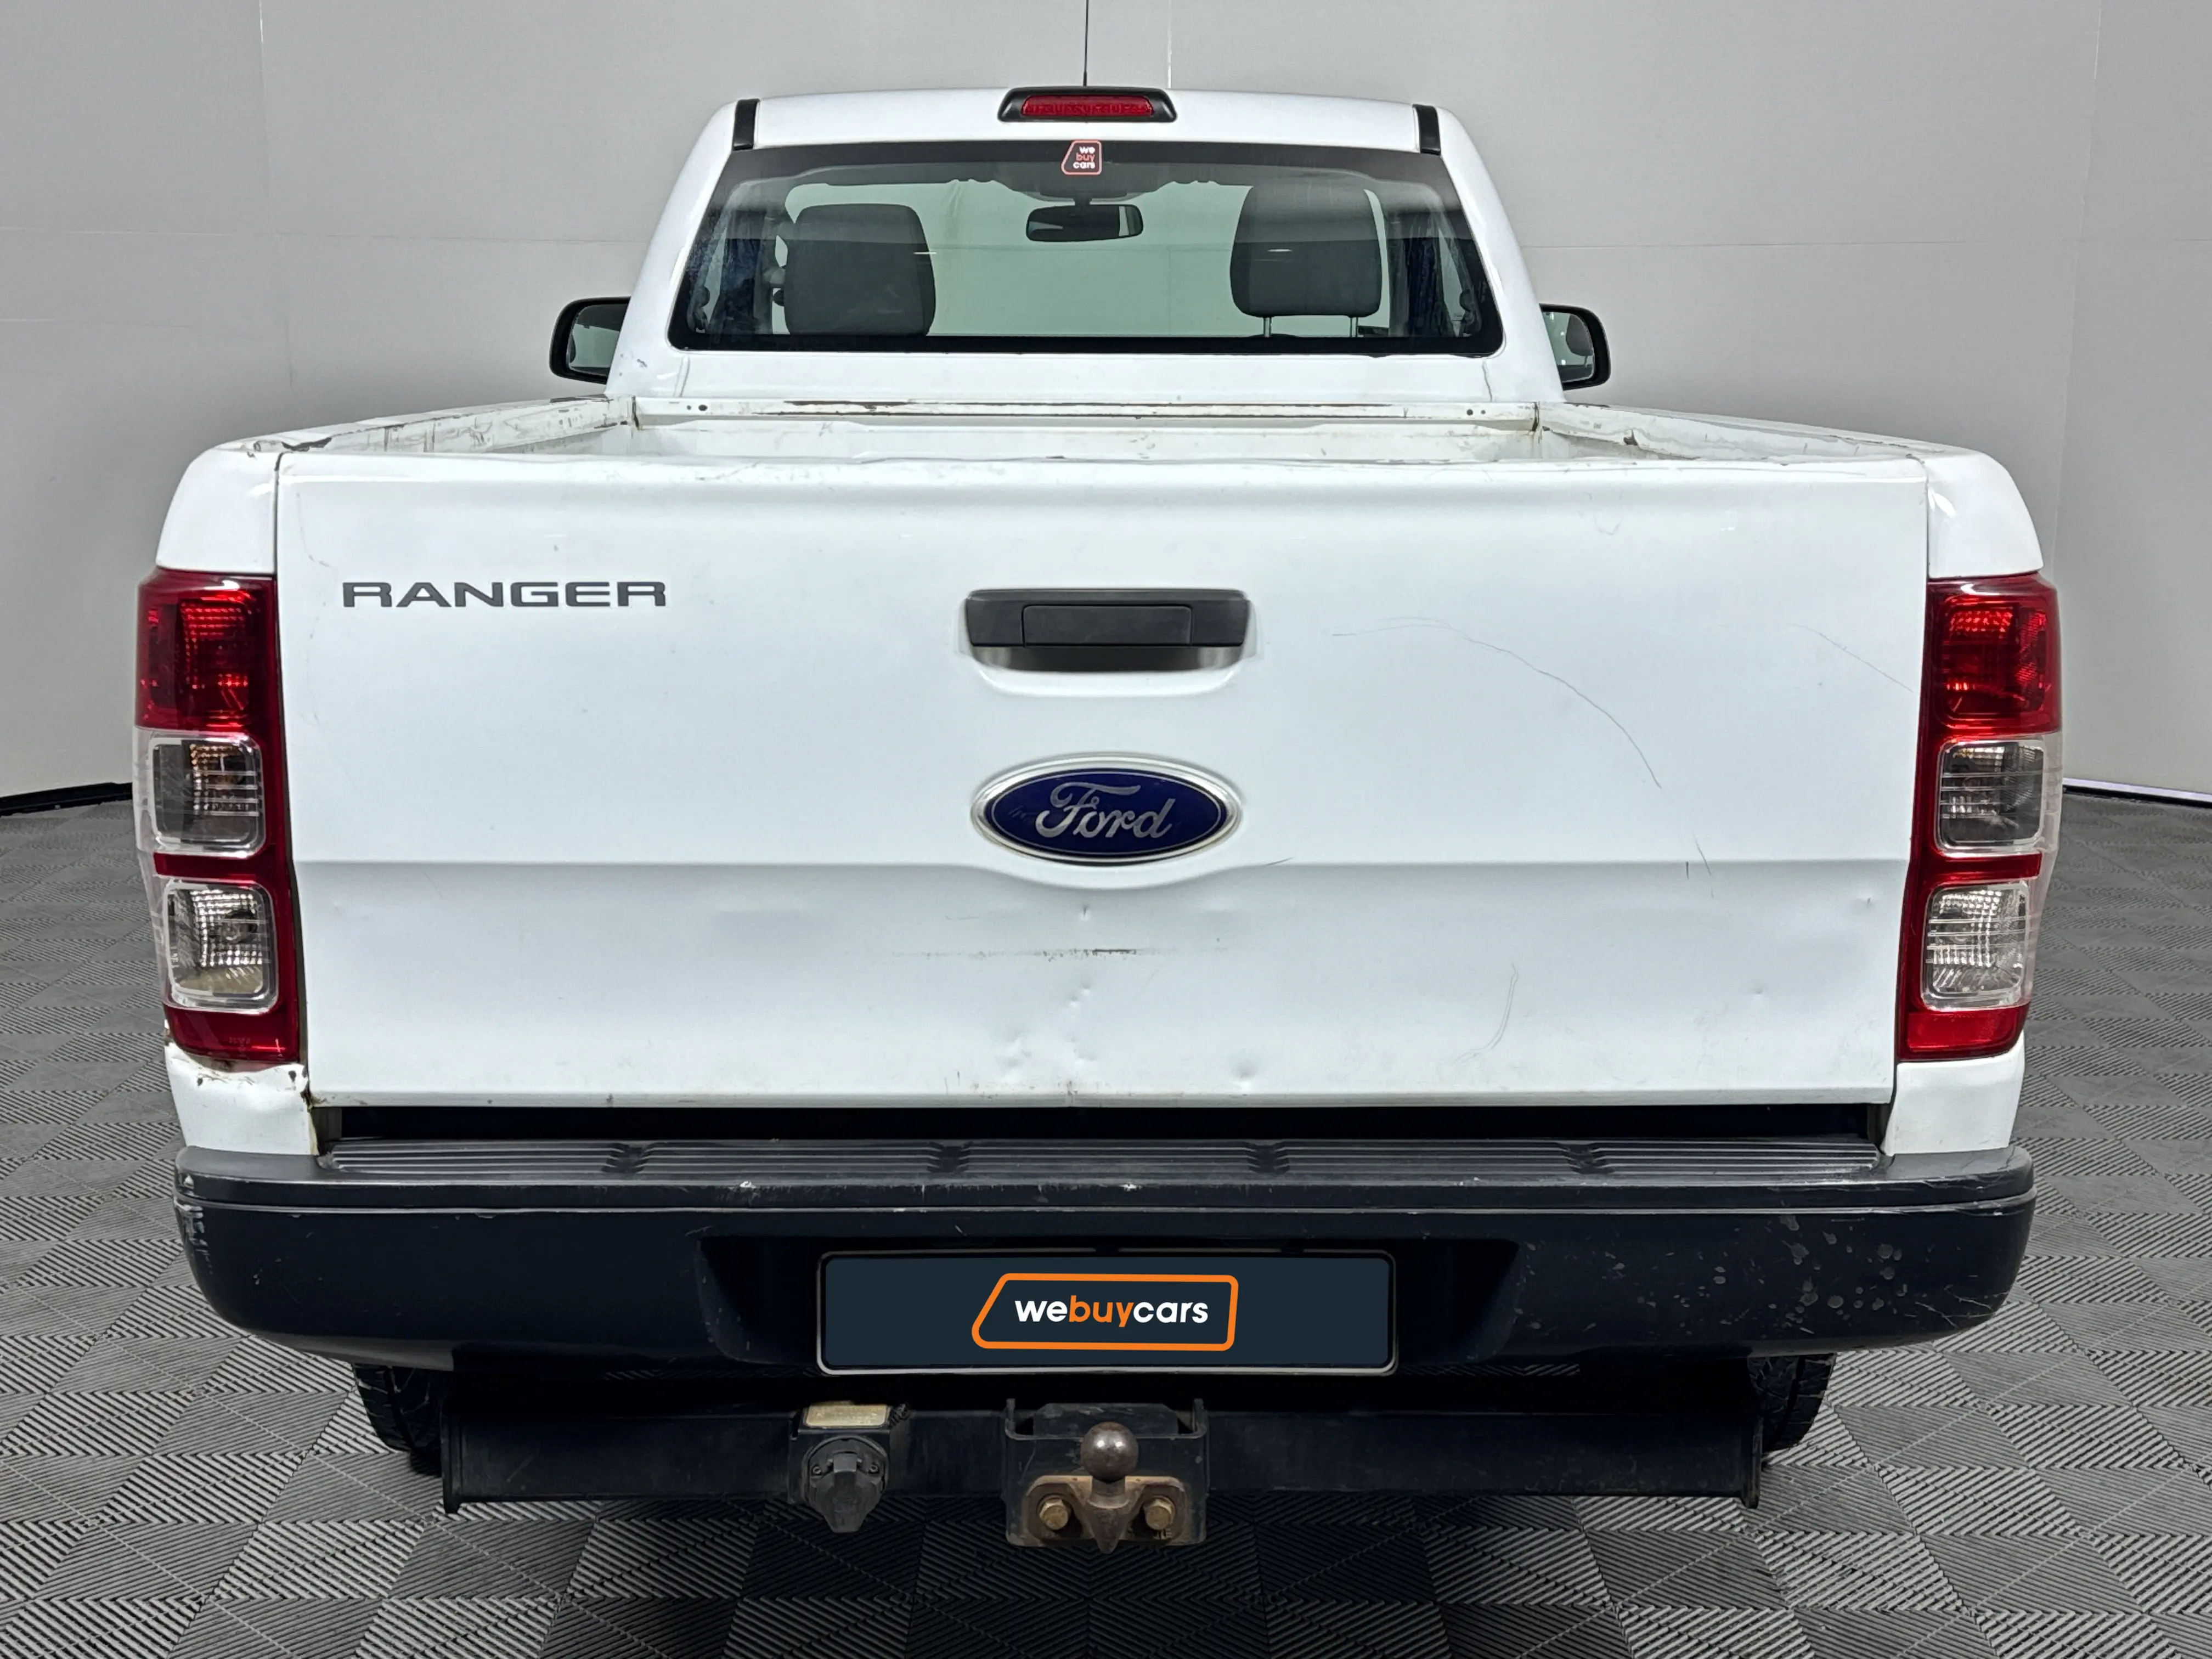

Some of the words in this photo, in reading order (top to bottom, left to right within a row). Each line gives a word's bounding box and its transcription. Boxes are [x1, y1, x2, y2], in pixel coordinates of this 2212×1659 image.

[1076, 153, 1095, 162] buy
[342, 582, 666, 607] RANGER
[1035, 781, 1176, 838] Ford
